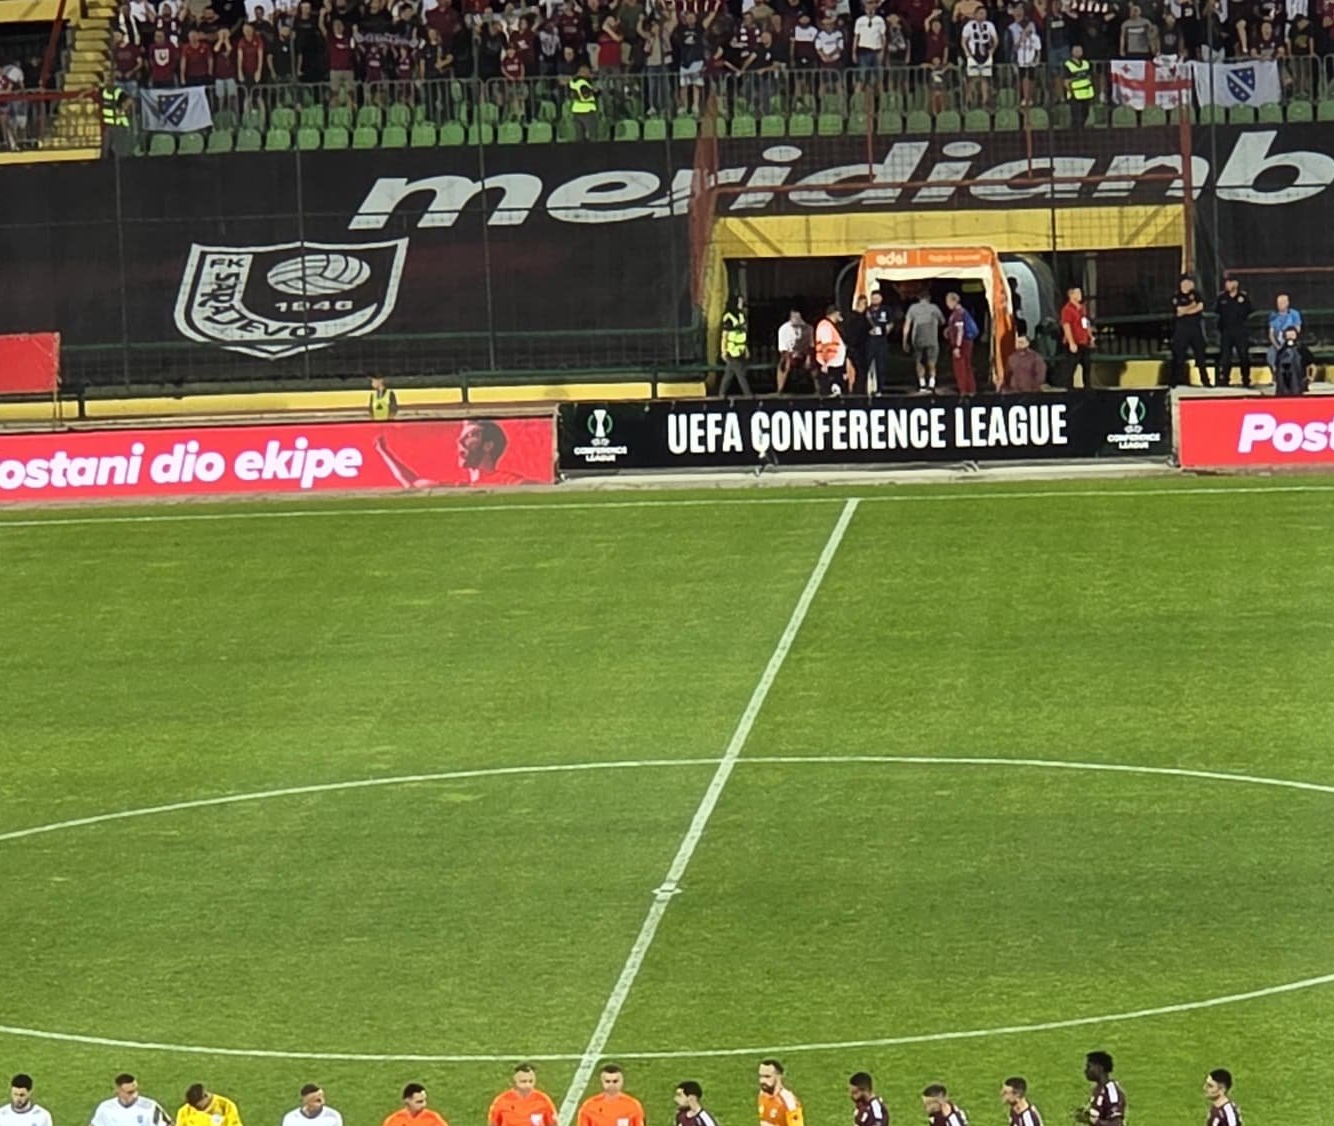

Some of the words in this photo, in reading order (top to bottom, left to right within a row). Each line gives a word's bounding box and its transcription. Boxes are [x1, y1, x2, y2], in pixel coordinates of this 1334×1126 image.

[667, 412, 744, 454] UEFA
[750, 408, 947, 453] CONFERENCE
[954, 404, 1068, 447] LEAGUE
[150, 440, 226, 484] dio
[234, 437, 363, 489] ekipe
